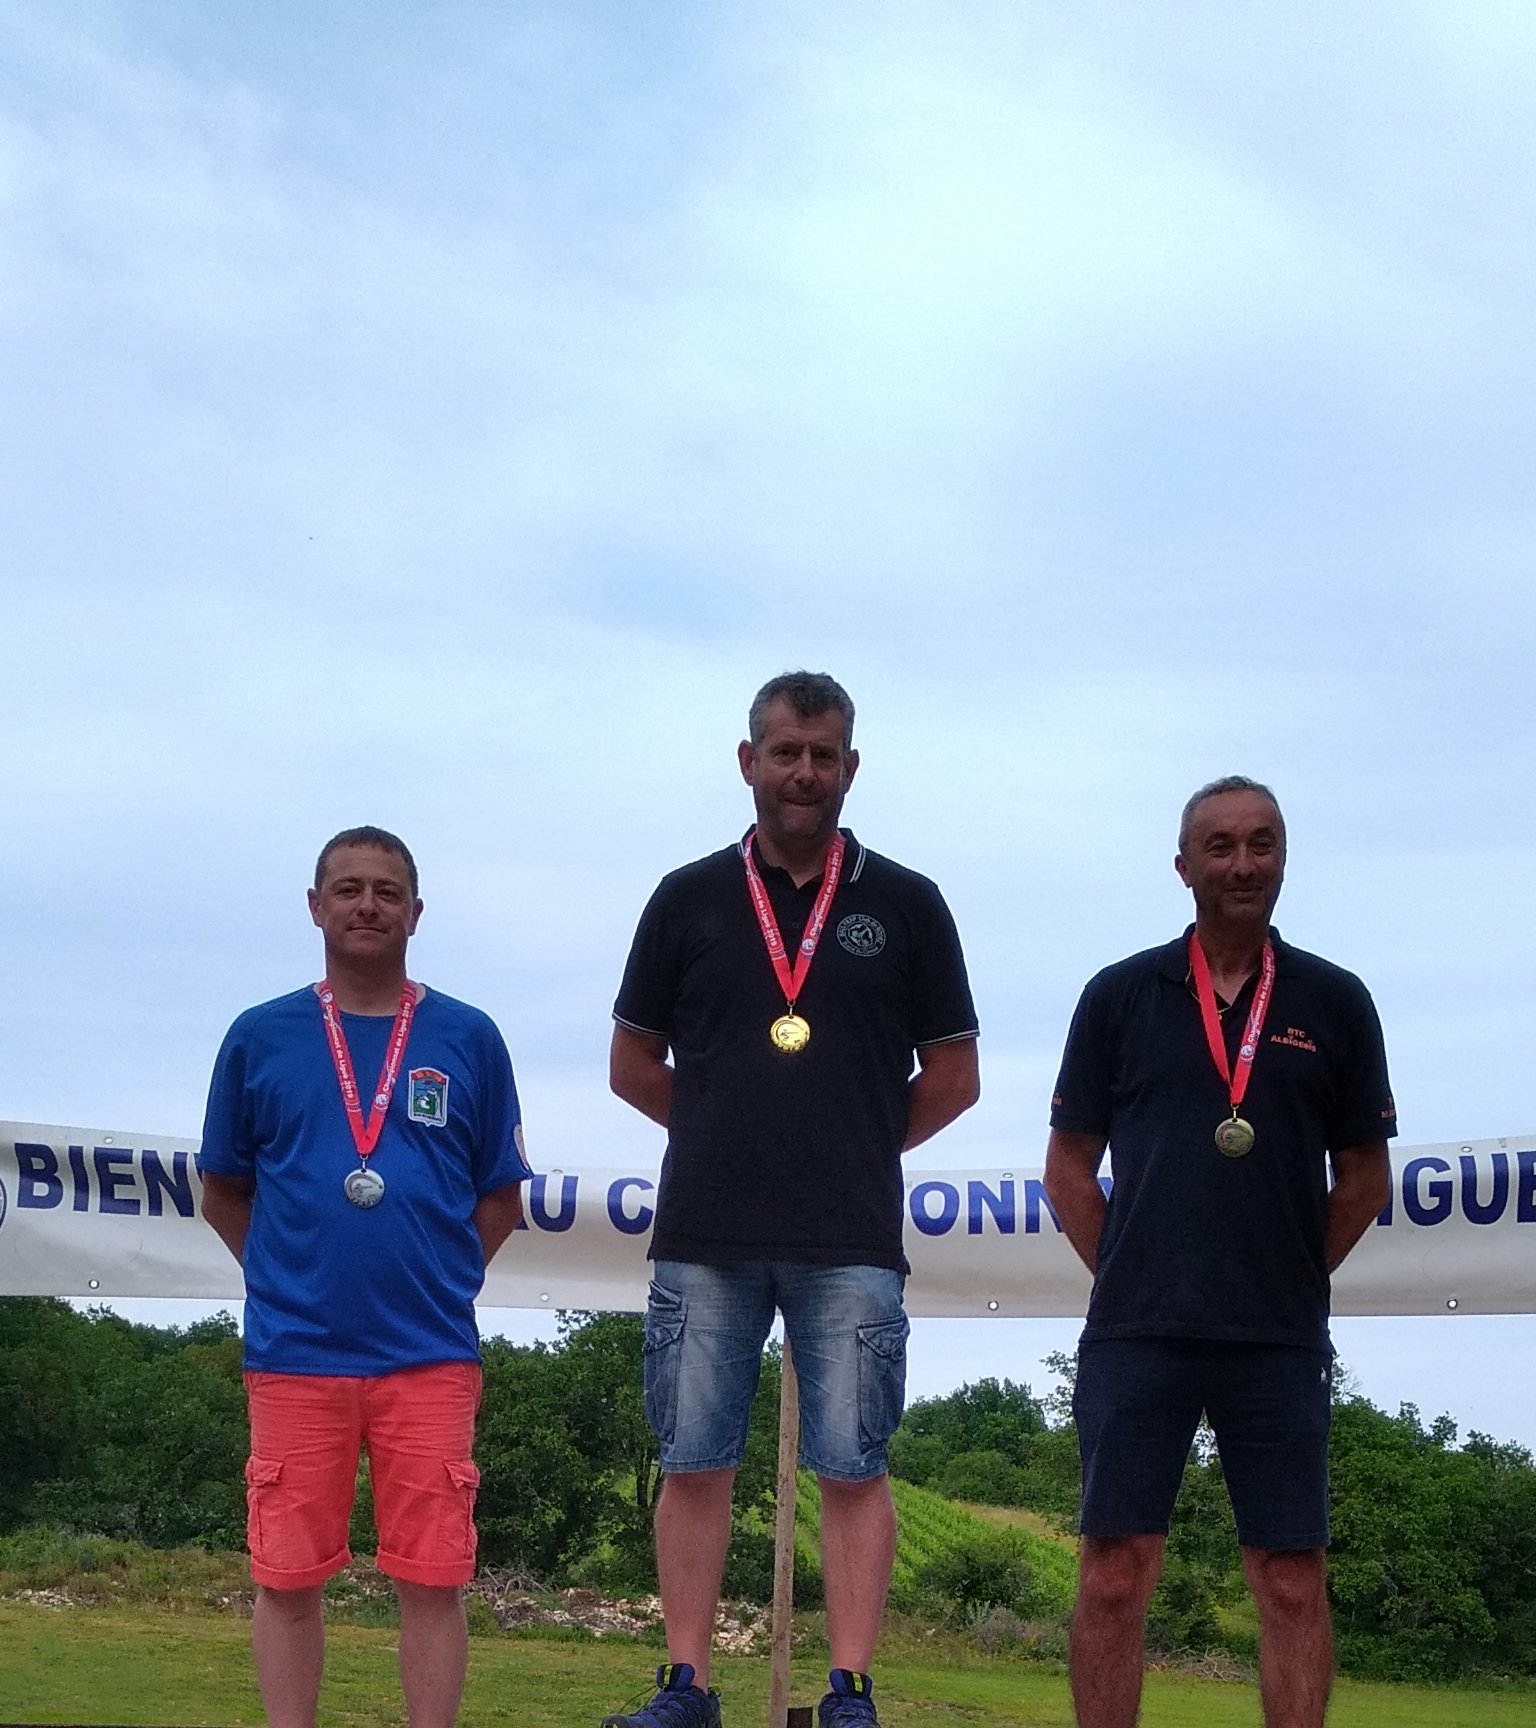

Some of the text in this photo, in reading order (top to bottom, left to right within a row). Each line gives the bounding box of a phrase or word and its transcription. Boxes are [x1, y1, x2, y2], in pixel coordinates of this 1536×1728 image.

[344, 1080, 354, 1099] 2019
[14, 1142, 201, 1218] BIEN
[517, 1174, 579, 1232] U
